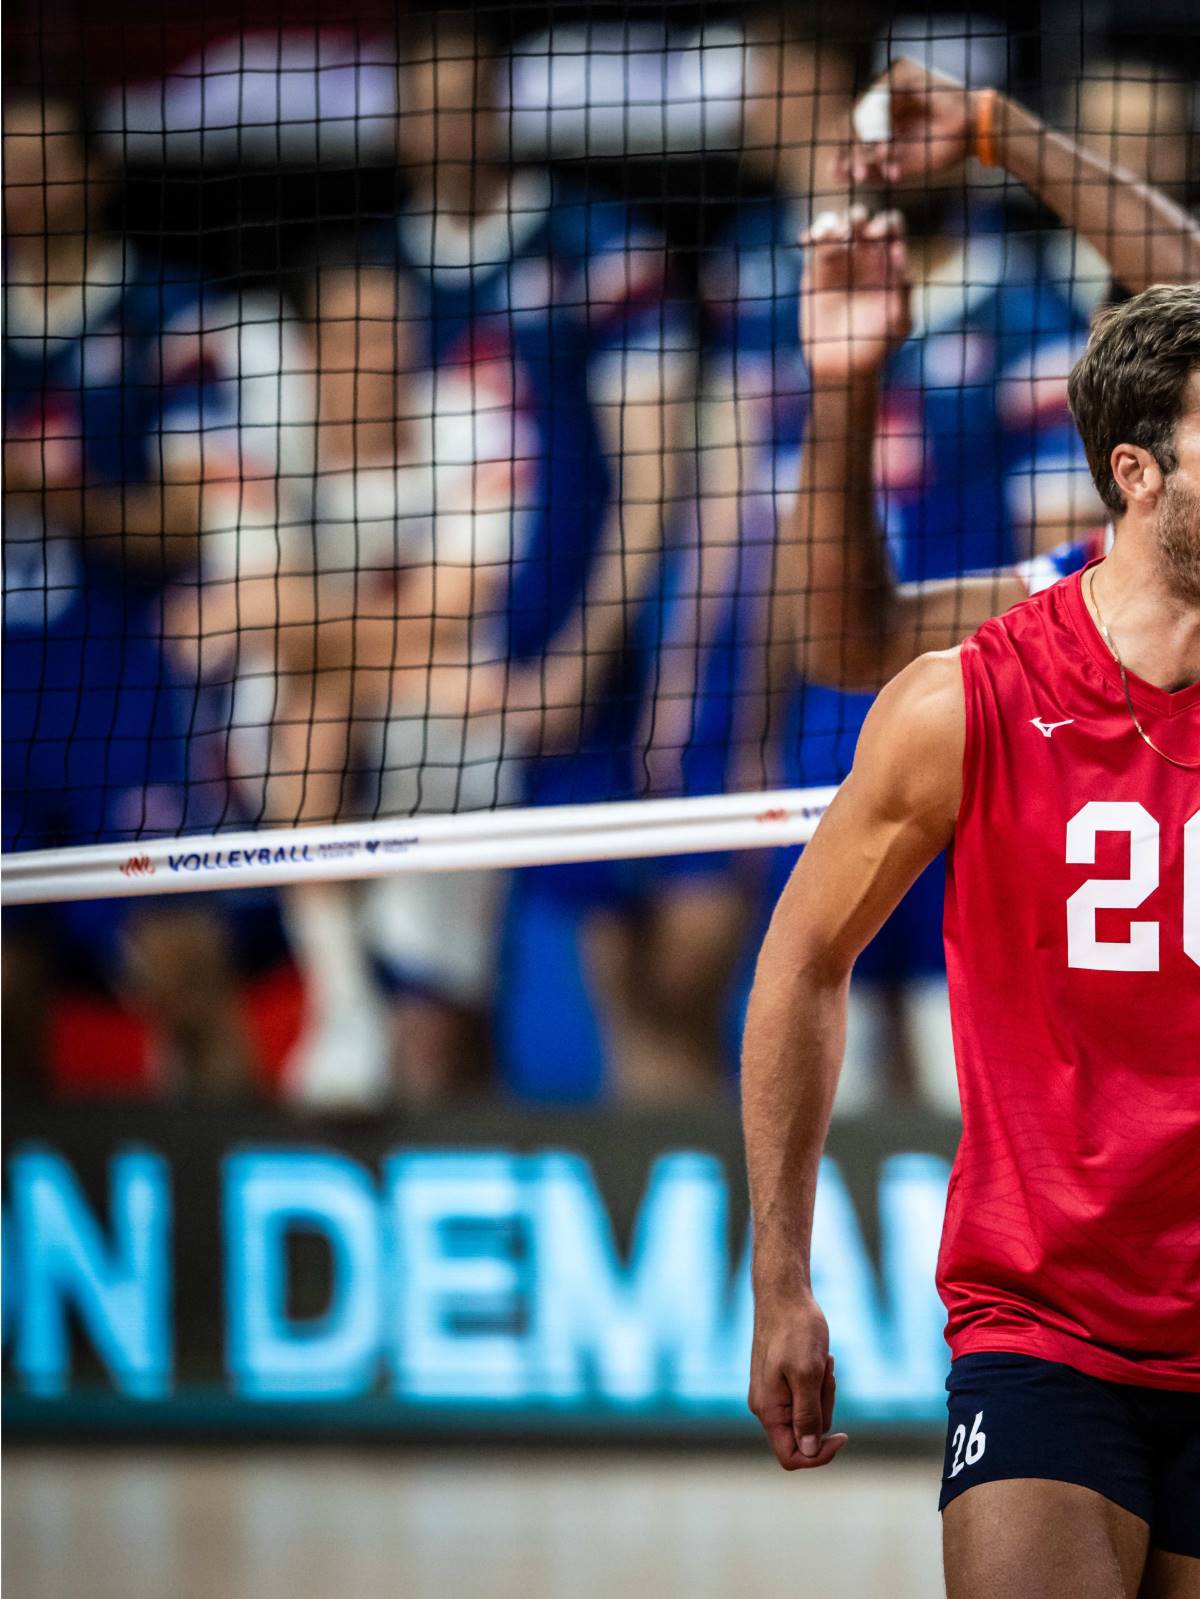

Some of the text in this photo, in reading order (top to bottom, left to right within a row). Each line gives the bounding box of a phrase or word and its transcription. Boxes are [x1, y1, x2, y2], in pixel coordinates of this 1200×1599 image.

[168, 845, 314, 872] VOLLEYBALL
[1, 1146, 170, 1399] N
[947, 1410, 986, 1479] 26
